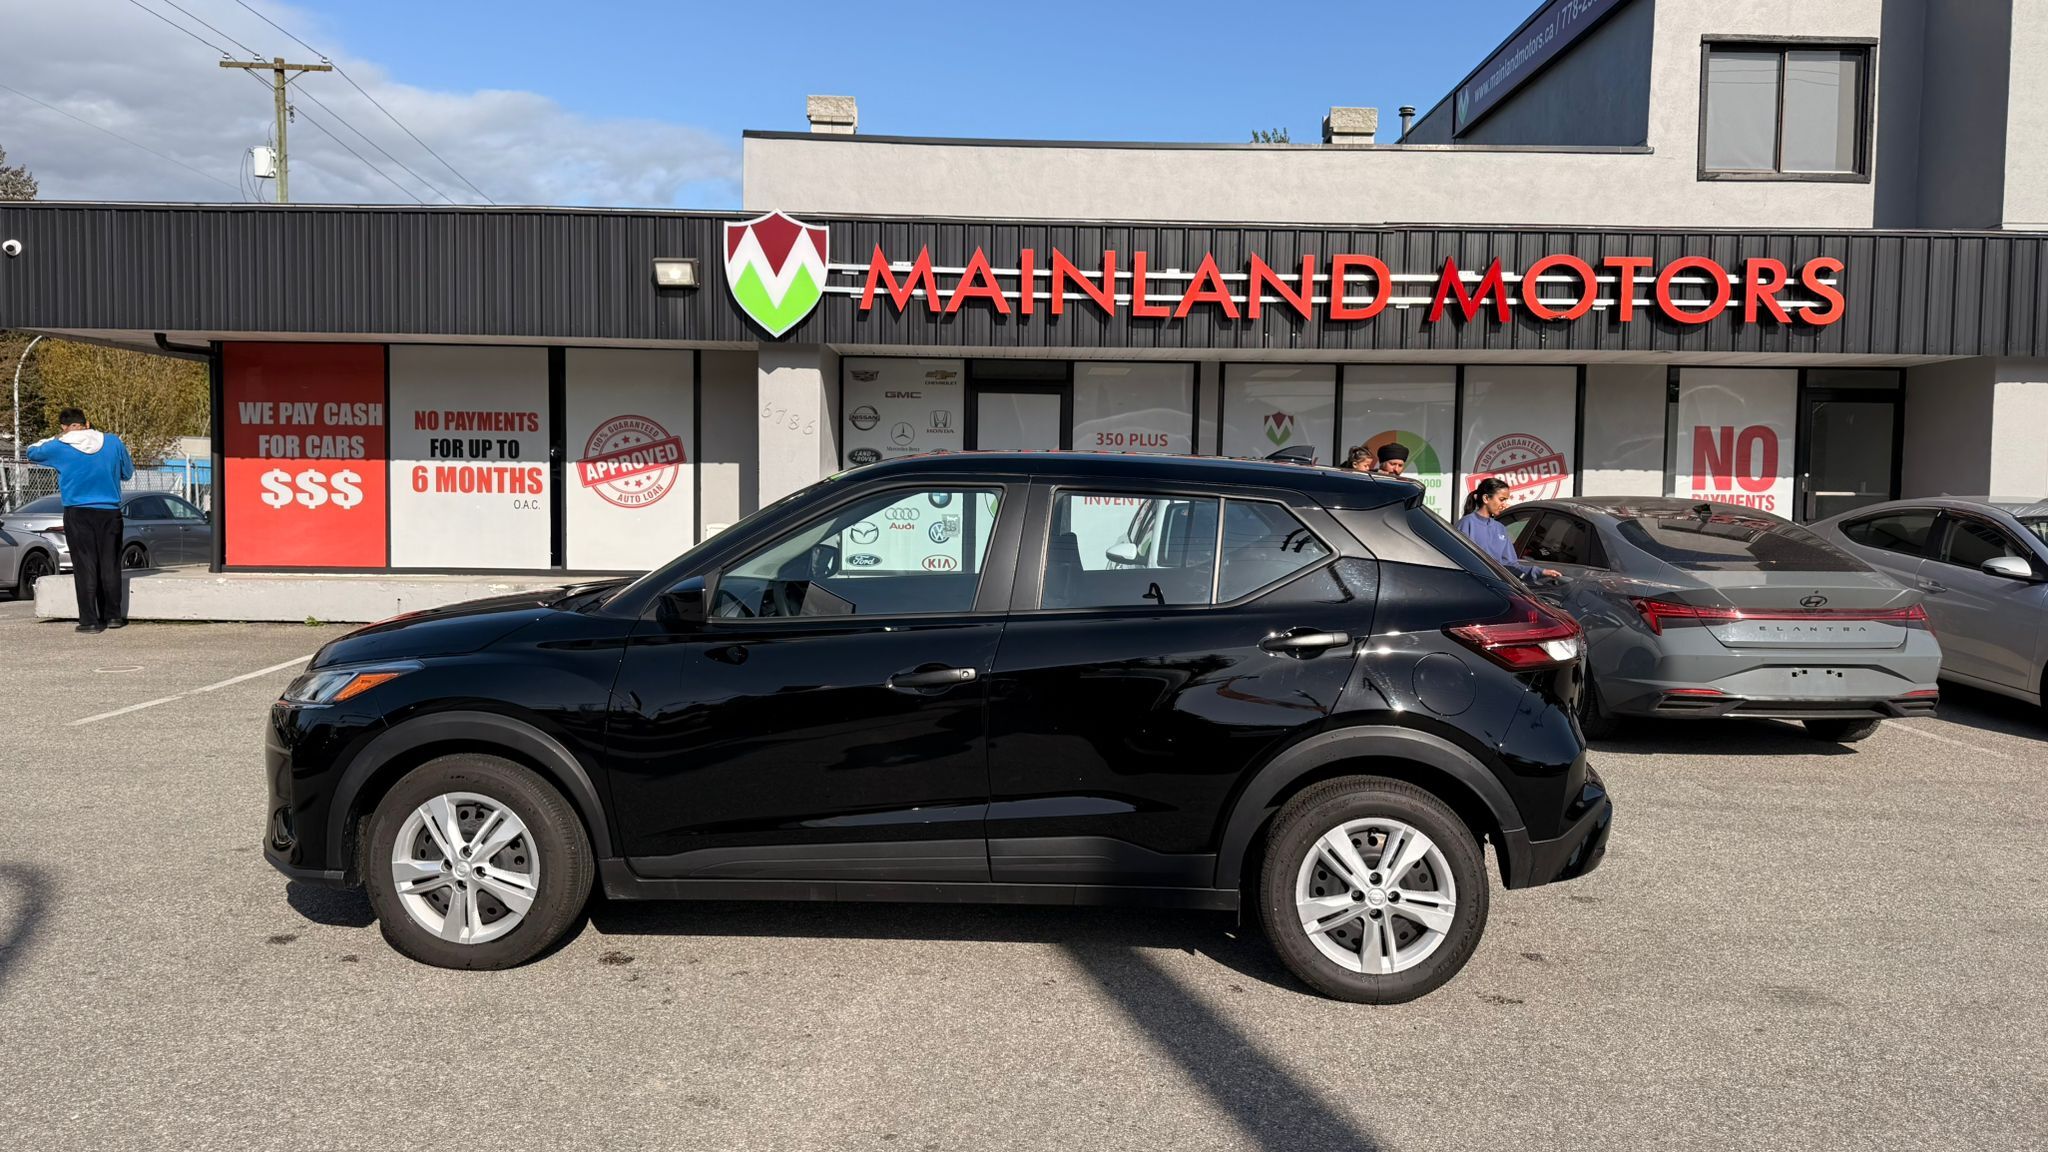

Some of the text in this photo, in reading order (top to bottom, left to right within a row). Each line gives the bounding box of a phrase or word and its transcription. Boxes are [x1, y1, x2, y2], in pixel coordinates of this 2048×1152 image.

[1474, 23, 1553, 102] www.mainlandmotors.ca
[859, 243, 1845, 326] MAINLAND MOTORS
[885, 391, 922, 399] GMC
[239, 402, 383, 426] WE PAY CASH
[414, 410, 539, 432] NO PAYMENTS
[761, 402, 816, 436] 6786
[258, 434, 365, 458] FOR CARS
[591, 420, 660, 452] 100% GUARANTEED
[1096, 432, 1168, 447] 350 PLUS
[430, 438, 520, 459] FOR UP TO
[1481, 439, 1544, 468] 100% GUARANTEED
[1692, 425, 1779, 493] NO
[586, 443, 679, 482] APPROVED
[260, 468, 364, 510] $$$
[412, 465, 543, 495] 6 MONTHS
[513, 499, 541, 510] O.A.C.
[617, 483, 664, 504] AUTO LOAN
[889, 522, 915, 531] Audi
[852, 555, 875, 566] Ford
[927, 558, 952, 569] KIA
